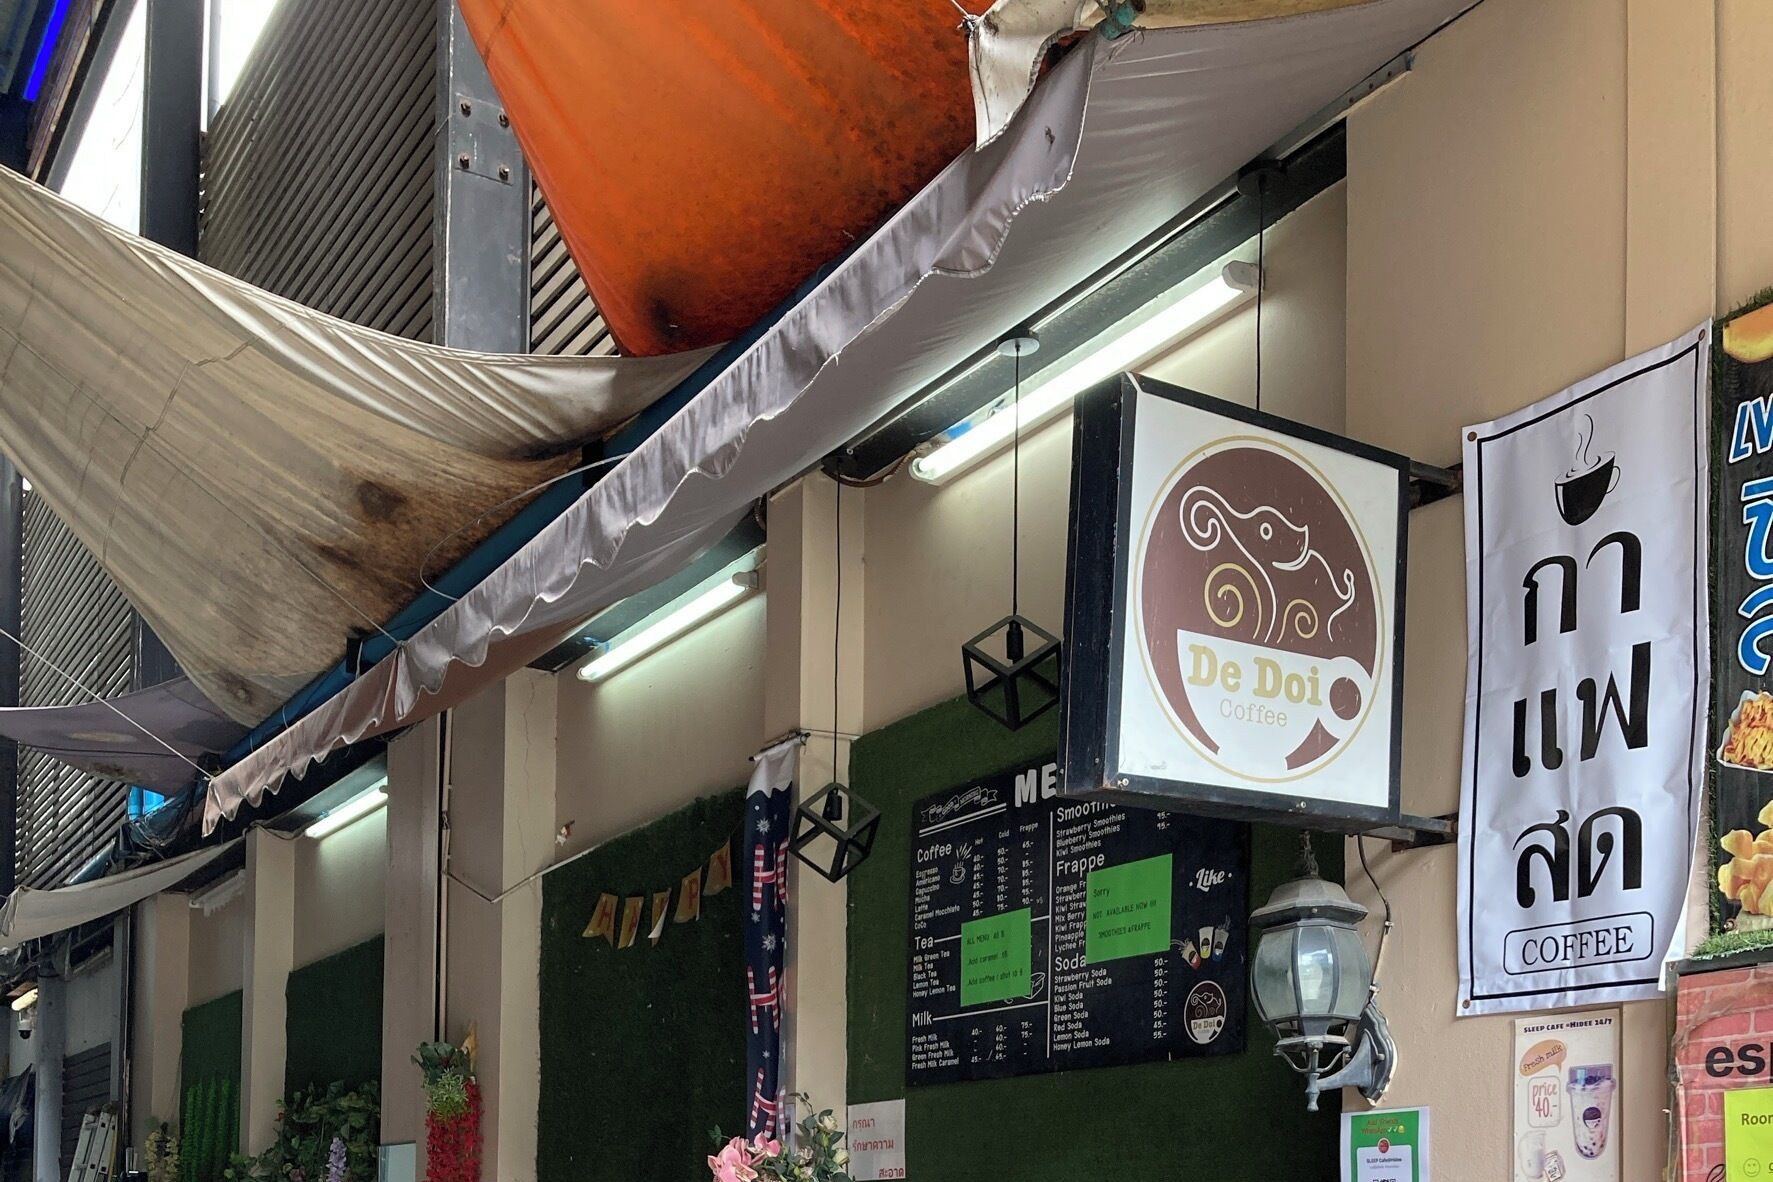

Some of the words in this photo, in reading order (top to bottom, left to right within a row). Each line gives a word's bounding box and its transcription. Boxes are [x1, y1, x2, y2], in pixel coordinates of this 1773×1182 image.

[1523, 531, 1643, 646] กา
[1187, 644, 1243, 690] De
[1252, 655, 1323, 708] Doi
[1219, 697, 1288, 728] Coffee
[1512, 641, 1652, 778] แฟ
[1015, 763, 1057, 808] ME
[1056, 822, 1091, 838] Strawberry
[1093, 813, 1126, 828] Smoothies
[1056, 834, 1086, 848] Blueberry
[1089, 824, 1120, 839] Smoothies
[917, 843, 952, 863] Coffee
[1070, 840, 1101, 854] Smoothies
[1513, 806, 1643, 909] สด
[1056, 853, 1105, 878] Frappe
[1196, 867, 1225, 892] Like
[1056, 884, 1078, 894] Orange
[1093, 888, 1110, 898] Sorry
[1056, 891, 1086, 904] Strawberr
[1067, 912, 1085, 922] Berry
[1092, 910, 1103, 920] NOT
[1106, 904, 1134, 916] AVAILABLE
[1069, 921, 1087, 931] Frapp
[914, 936, 934, 951] Tea
[1055, 931, 1084, 943] Pineapple
[1055, 942, 1077, 952] Lychee
[1521, 925, 1634, 967] COFFEE
[913, 955, 923, 964] Milk
[924, 953, 939, 963] Green
[941, 950, 950, 958] Tea
[1055, 953, 1086, 971] Soda
[913, 964, 923, 973] Milk
[924, 962, 933, 970] Tea
[913, 973, 926, 981] Black
[1055, 970, 1089, 984] Strawberry
[1091, 968, 1107, 977] Soda
[913, 981, 929, 990] Lemon
[913, 990, 928, 998] Honey
[929, 987, 945, 996] Lemon
[946, 984, 956, 992] Tea
[1055, 983, 1077, 993] Passion
[1079, 979, 1094, 990] Fruit
[1096, 977, 1112, 987] Soda
[1054, 994, 1066, 1003] Kiwi
[1068, 991, 1083, 1001] Soda
[1054, 1003, 1067, 1013] Blue
[1069, 1001, 1083, 1011] Soda
[912, 1011, 932, 1028] Milk
[1054, 1013, 1072, 1022] Green
[1074, 1010, 1089, 1019] Soda
[1054, 1023, 1065, 1032] Red
[1067, 1021, 1082, 1030] Soda
[1192, 1020, 1202, 1030] De
[1203, 1019, 1216, 1029] Doi
[1523, 1024, 1545, 1034] SLEEP
[1546, 1022, 1564, 1032] CAFE
[912, 1035, 927, 1044] Fresh
[928, 1033, 938, 1042] Milk
[1054, 1032, 1072, 1042] Lemon
[1074, 1030, 1089, 1039] Soda
[912, 1044, 922, 1053] Pink
[924, 1042, 939, 1051] Fresh
[940, 1040, 950, 1049] Milk
[1053, 1042, 1071, 1052] Honey
[1074, 1039, 1093, 1050] Lemon
[1094, 1036, 1110, 1046] Soda
[912, 1053, 927, 1062] Green
[928, 1051, 943, 1060] Fresh
[944, 1048, 954, 1057] Milk
[912, 1062, 926, 1070] Fresh
[928, 1060, 937, 1068] Milk
[939, 1057, 960, 1067] Caramel
[1532, 1082, 1557, 1106] price
